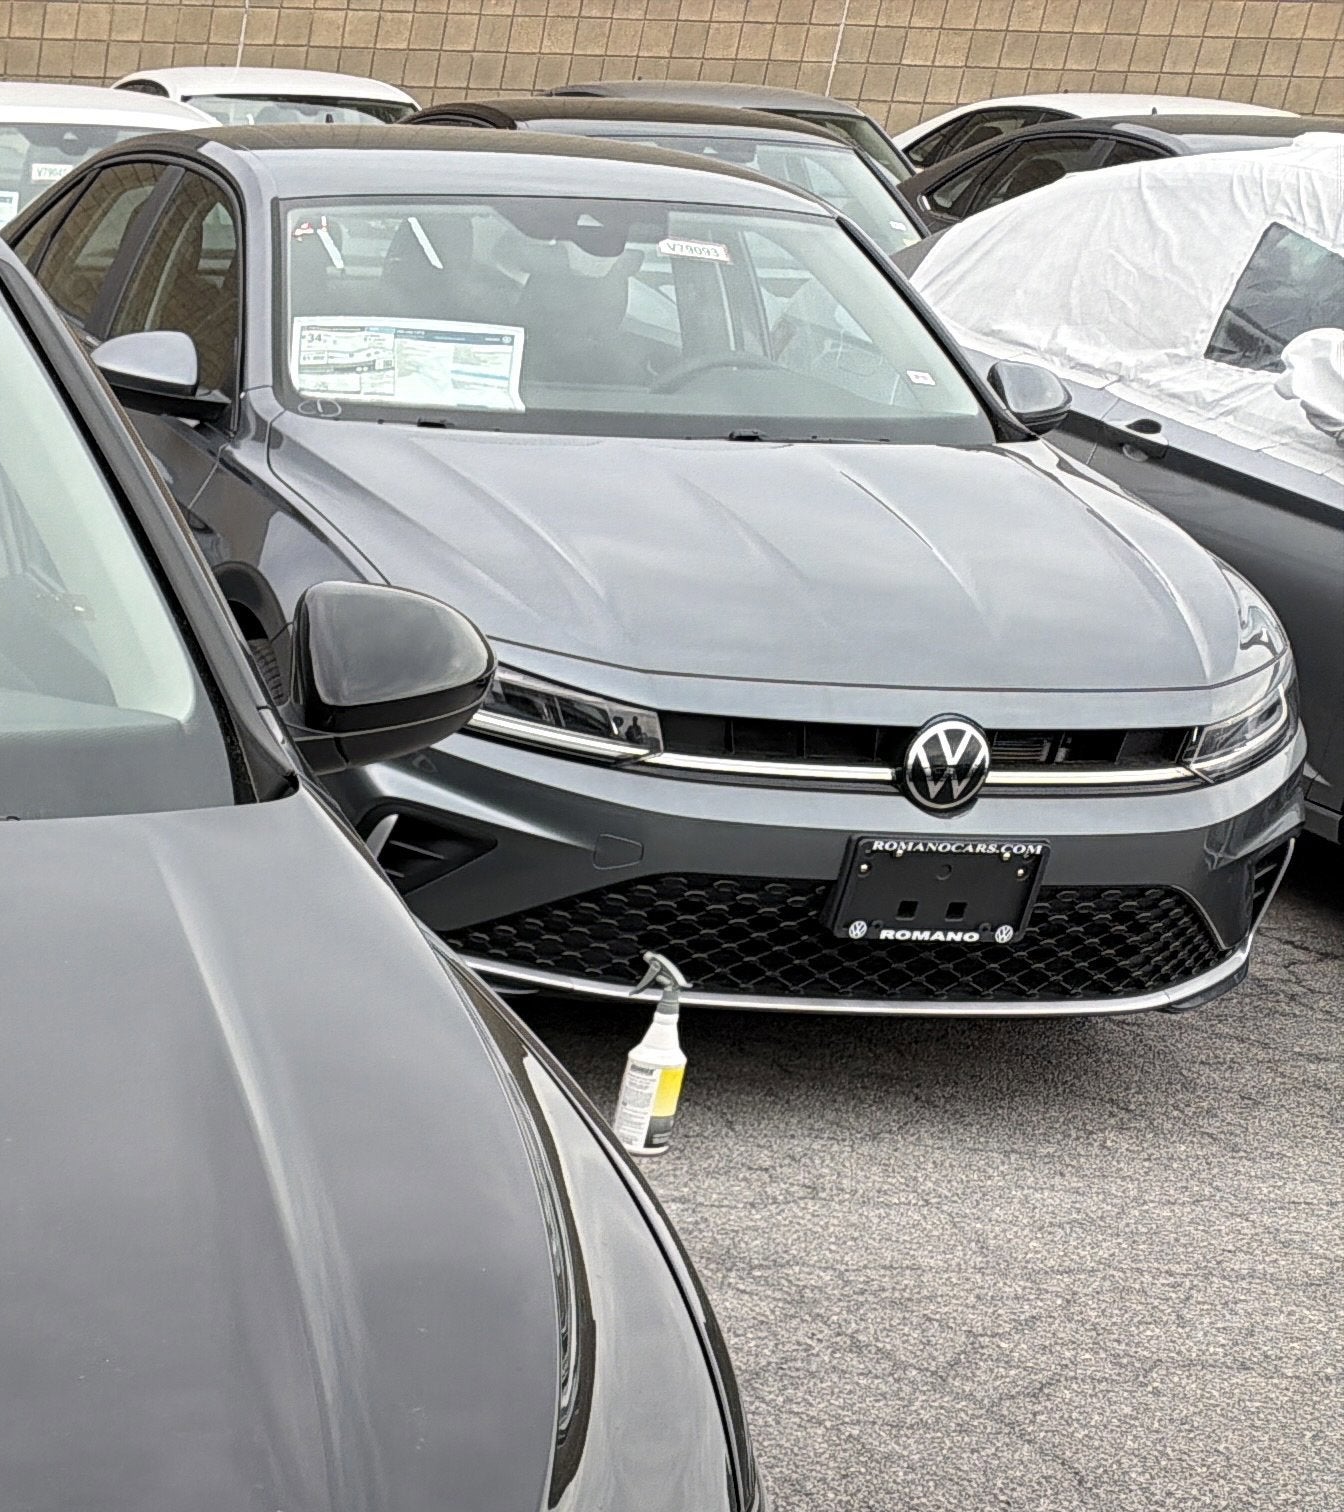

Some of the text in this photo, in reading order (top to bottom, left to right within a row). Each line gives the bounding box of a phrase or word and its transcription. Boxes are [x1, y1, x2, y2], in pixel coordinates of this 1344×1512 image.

[666, 242, 720, 258] V79093
[871, 839, 1043, 855] ROMANOCARS.COM
[879, 929, 980, 943] ROMANO
